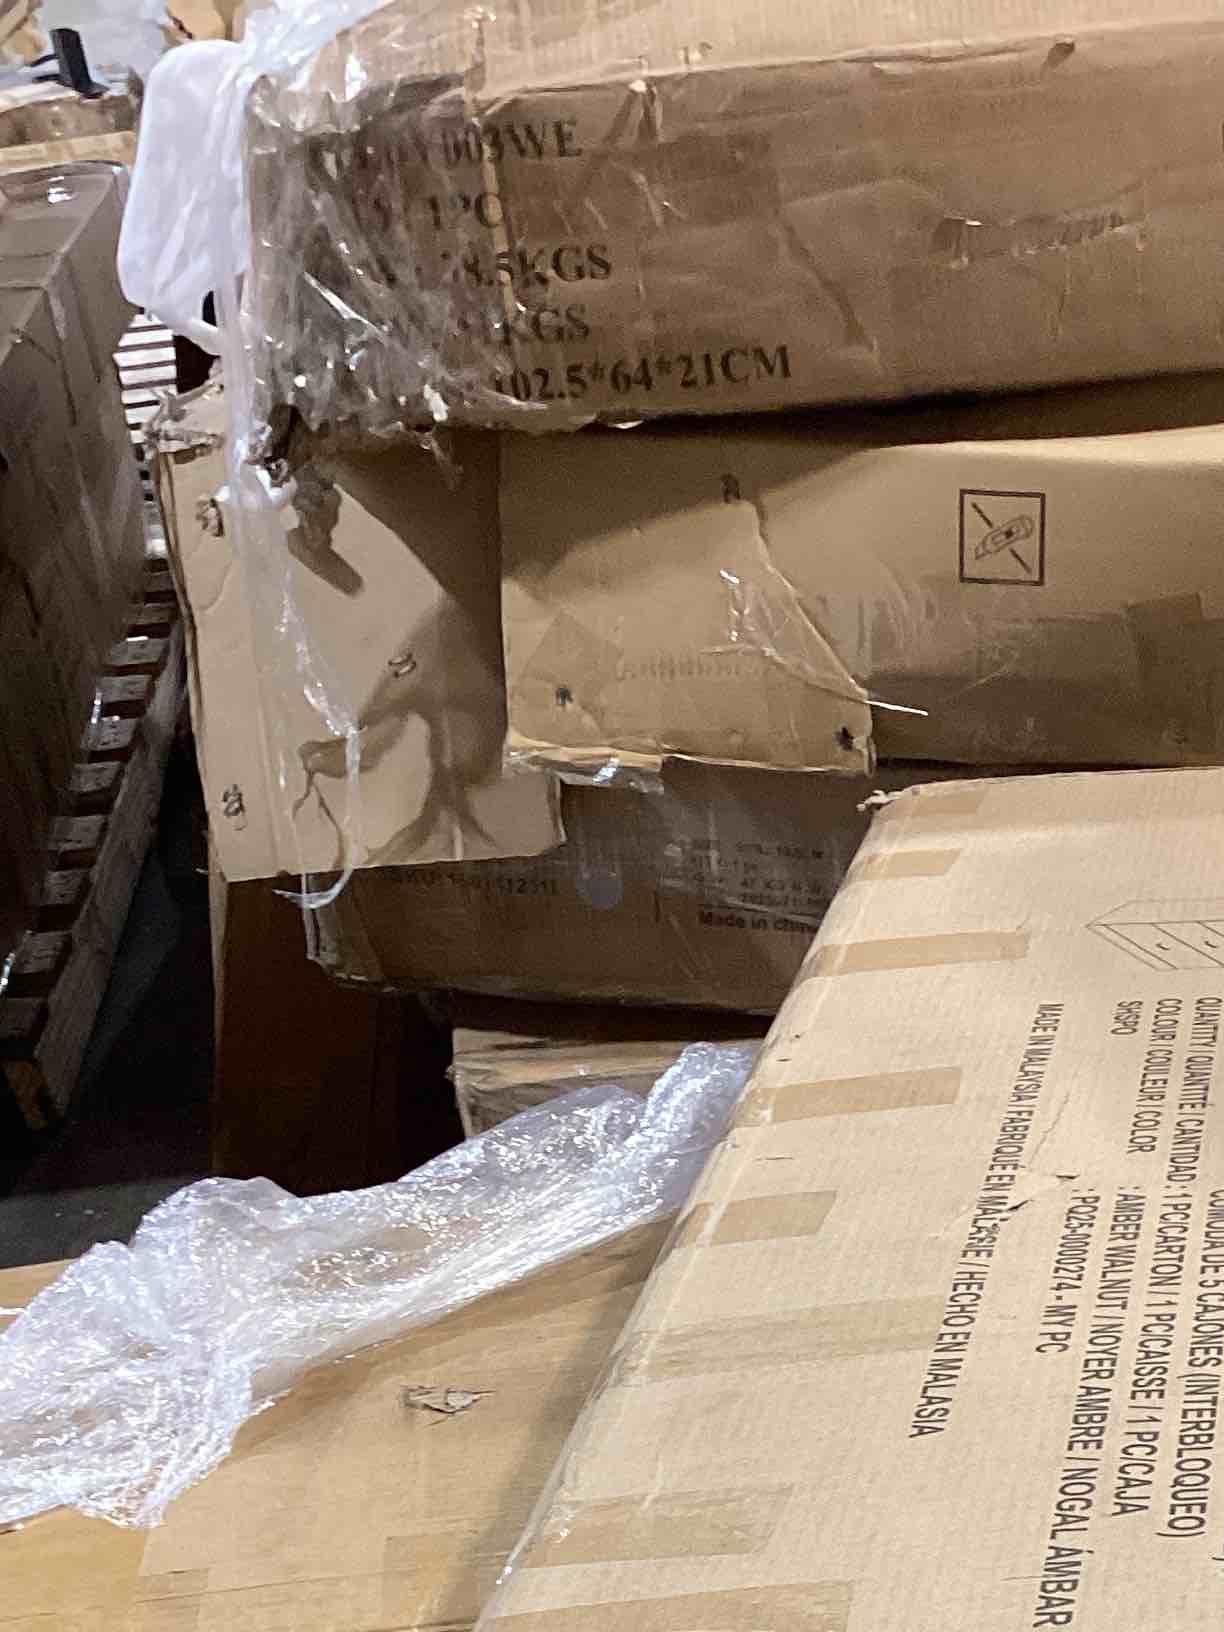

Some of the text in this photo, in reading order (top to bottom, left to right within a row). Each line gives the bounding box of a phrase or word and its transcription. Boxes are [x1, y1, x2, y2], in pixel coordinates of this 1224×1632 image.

[1026, 1035, 1056, 1047] IN
[1030, 1003, 1065, 1032] MADE
[1110, 1000, 1144, 1035] SHSPO
[1152, 998, 1183, 1041] COLOUR
[1187, 997, 1223, 1047] QUANTITY
[1008, 1048, 1053, 1103] MALAYSIA
[1139, 1049, 1173, 1101] COULEUR
[1127, 1111, 1162, 1154] COLOR
[1167, 1119, 1204, 1182] CANTIDAD
[983, 1175, 1016, 1191] EN
[1108, 1193, 1145, 1242] AMBER
[1149, 1202, 1192, 1287] PC/CARTON
[942, 1271, 986, 1327] HECHO
[1095, 1244, 1138, 1310] WALNUT
[933, 1331, 969, 1353] EN
[1035, 1331, 1072, 1354] PC
[1038, 1303, 1079, 1329] MY
[1080, 1323, 1125, 1382] NOYER
[1129, 1313, 1177, 1400] PC/CAISSE
[909, 1358, 963, 1439] MALASIA
[1066, 1385, 1113, 1452] AMBRE
[1112, 1430, 1162, 1517] PC/CAJA
[1155, 1372, 1221, 1538] (INTERBLOQUEO)
[1048, 1466, 1100, 1541] NOGAL
[1032, 1544, 1095, 1628] ÁMBAR
